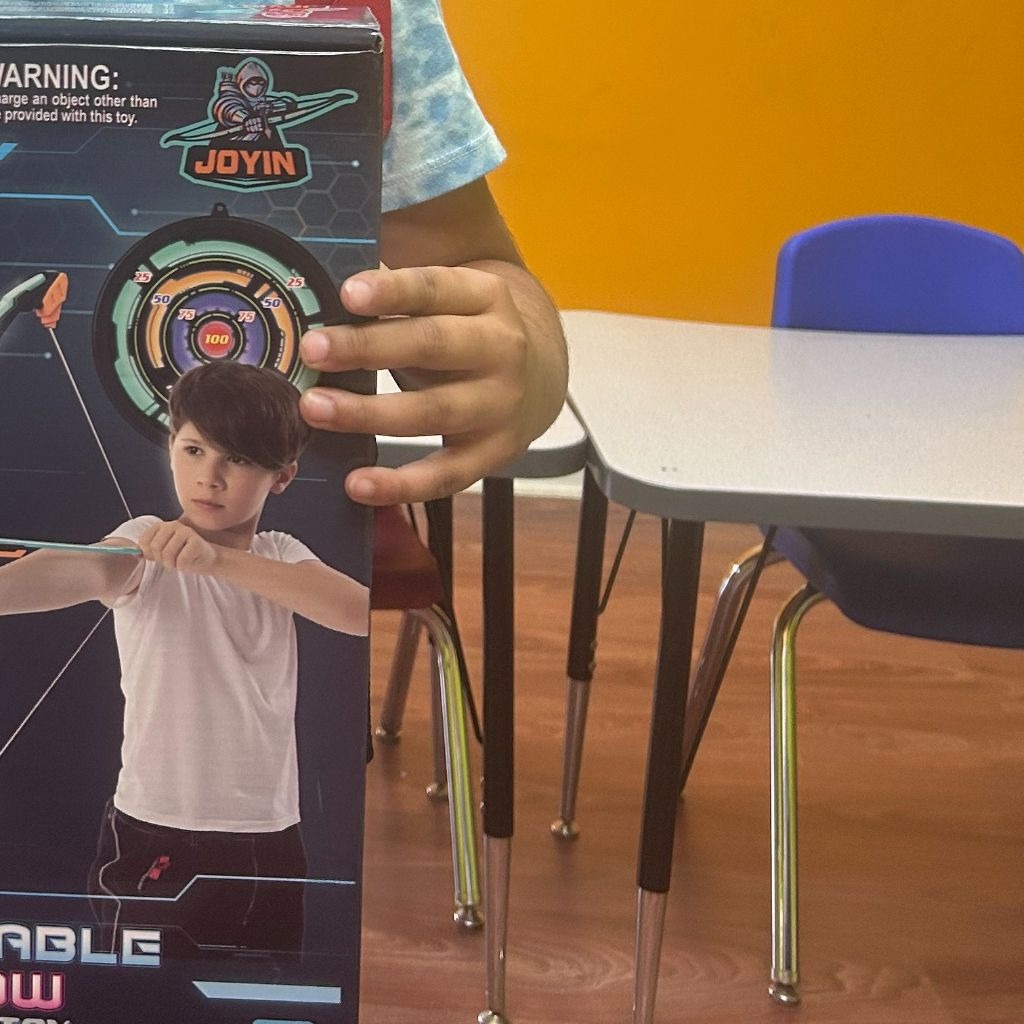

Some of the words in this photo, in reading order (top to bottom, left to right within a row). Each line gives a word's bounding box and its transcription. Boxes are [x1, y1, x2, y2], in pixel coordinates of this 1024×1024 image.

[32, 95, 48, 105] an
[51, 92, 90, 108] object
[94, 94, 127, 108] other
[130, 95, 158, 108] than
[4, 107, 58, 124] provided
[61, 108, 87, 122] with
[90, 109, 113, 124] this
[115, 111, 138, 127] toy.
[194, 149, 296, 176] JOYIN
[134, 271, 153, 283] 25
[286, 276, 305, 288] 25
[151, 293, 171, 305] 50
[262, 297, 281, 308] 50
[177, 308, 196, 321] 75
[237, 311, 256, 323] 75
[205, 333, 229, 345] 100
